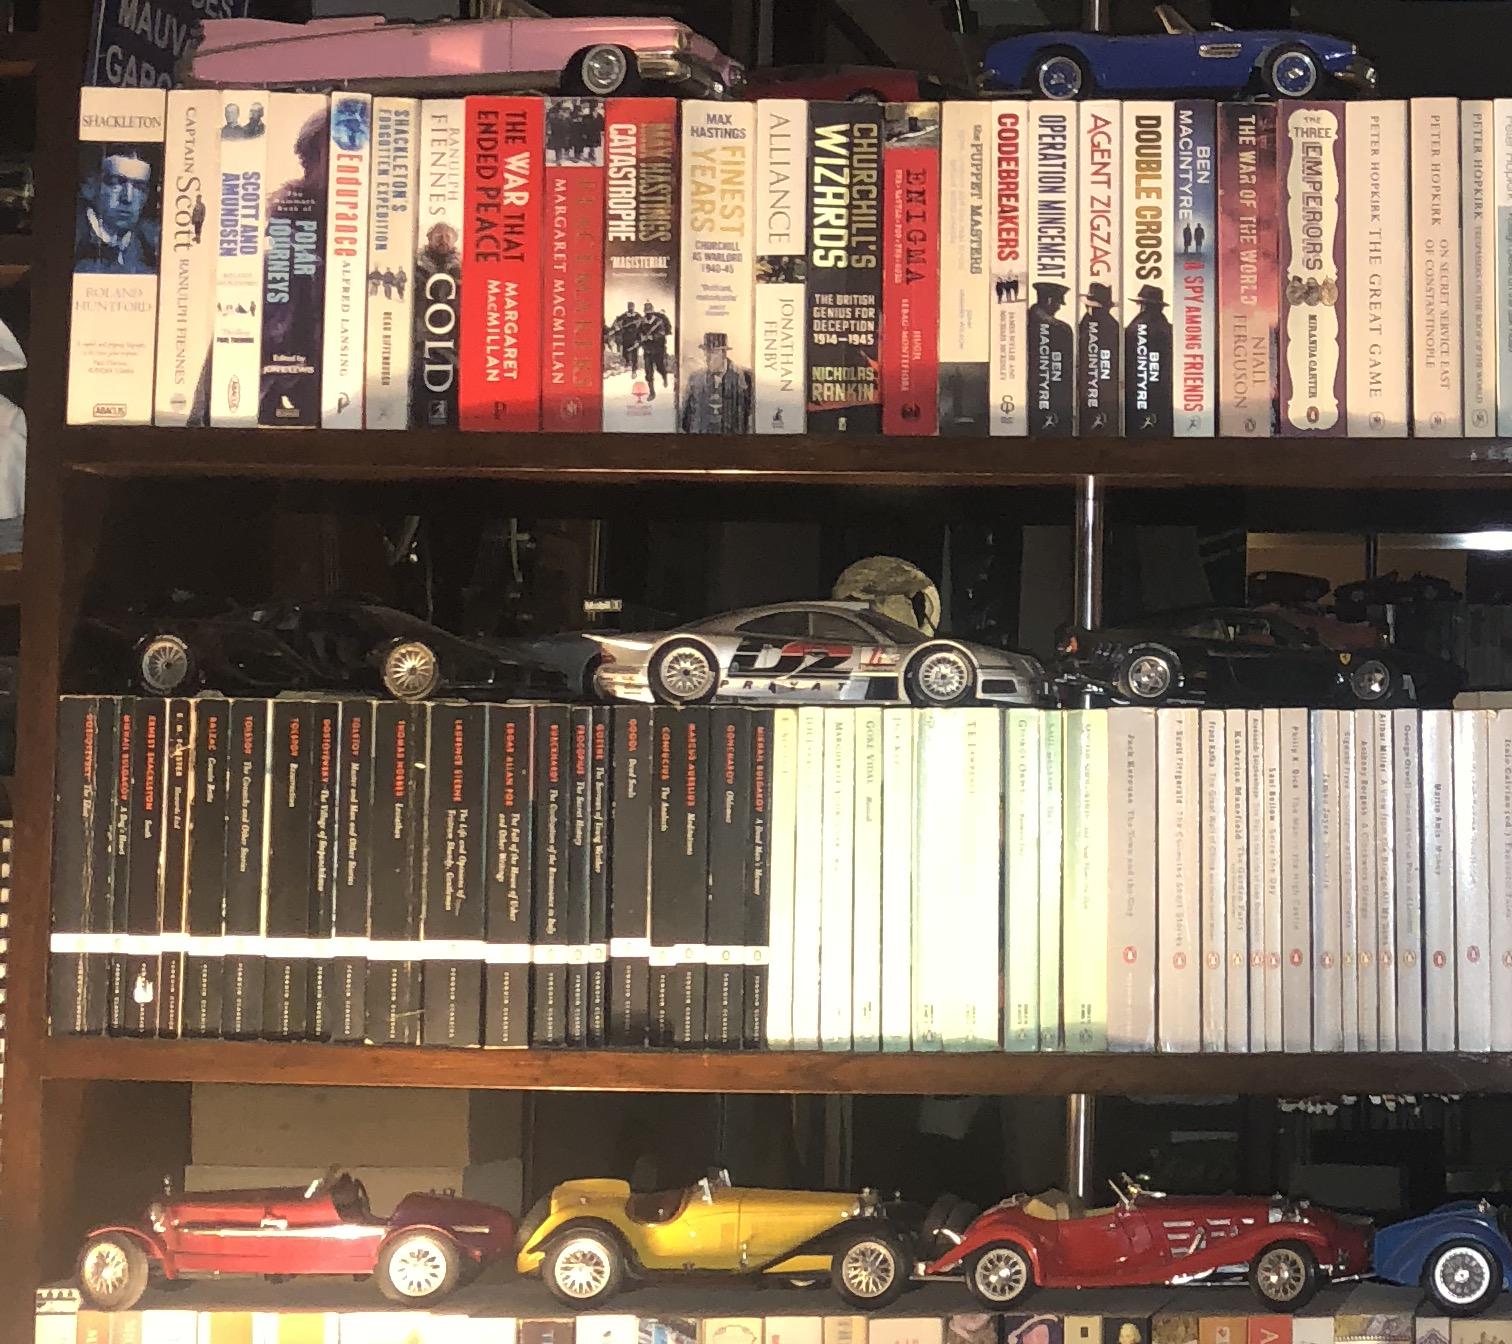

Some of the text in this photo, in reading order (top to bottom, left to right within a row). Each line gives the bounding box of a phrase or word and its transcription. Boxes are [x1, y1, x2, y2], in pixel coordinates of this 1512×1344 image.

[82, 114, 161, 129] SHACKLETON
[691, 126, 746, 140] HASTINGS
[706, 113, 731, 126] MAX
[768, 113, 790, 244] ALLIANCE
[335, 153, 363, 256] Endurance
[474, 110, 499, 263] ENDED PEACE
[503, 111, 529, 262] THE WAR THAT
[609, 123, 636, 242] CATASTROPHE
[813, 123, 852, 269] WIZARDS
[851, 122, 877, 269] CHURCHILL'S
[996, 113, 1019, 262] CODEBREAKERS
[1038, 115, 1066, 279] OPERATION MINCEMEAT
[1135, 115, 1162, 279] DOUBLE CROSS
[1302, 142, 1323, 270] EMPERORS
[424, 272, 456, 393] COLD
[503, 282, 518, 380] MARGARET
[813, 307, 875, 319] GENIUS FOR
[813, 321, 875, 332] DECEPTION
[815, 294, 875, 306] THE BRITISH
[812, 367, 874, 381] NICHOLAS
[812, 383, 874, 402] RANKIN
